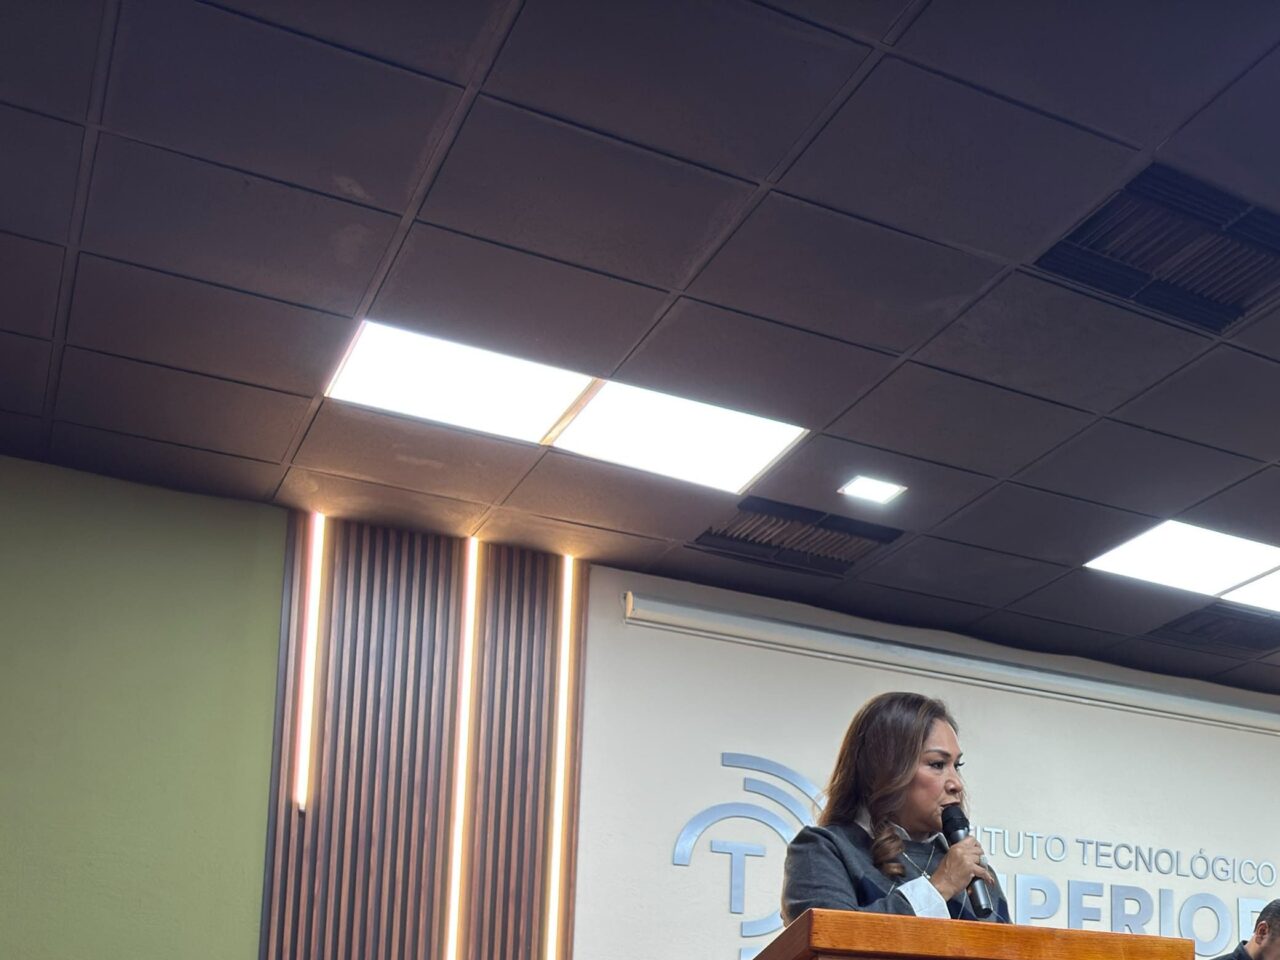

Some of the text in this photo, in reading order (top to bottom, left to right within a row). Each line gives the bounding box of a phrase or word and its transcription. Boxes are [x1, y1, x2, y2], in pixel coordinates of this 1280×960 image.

[969, 824, 1277, 887] ITUTO TECNOLÓGICO
[997, 872, 1268, 957] PERIO
